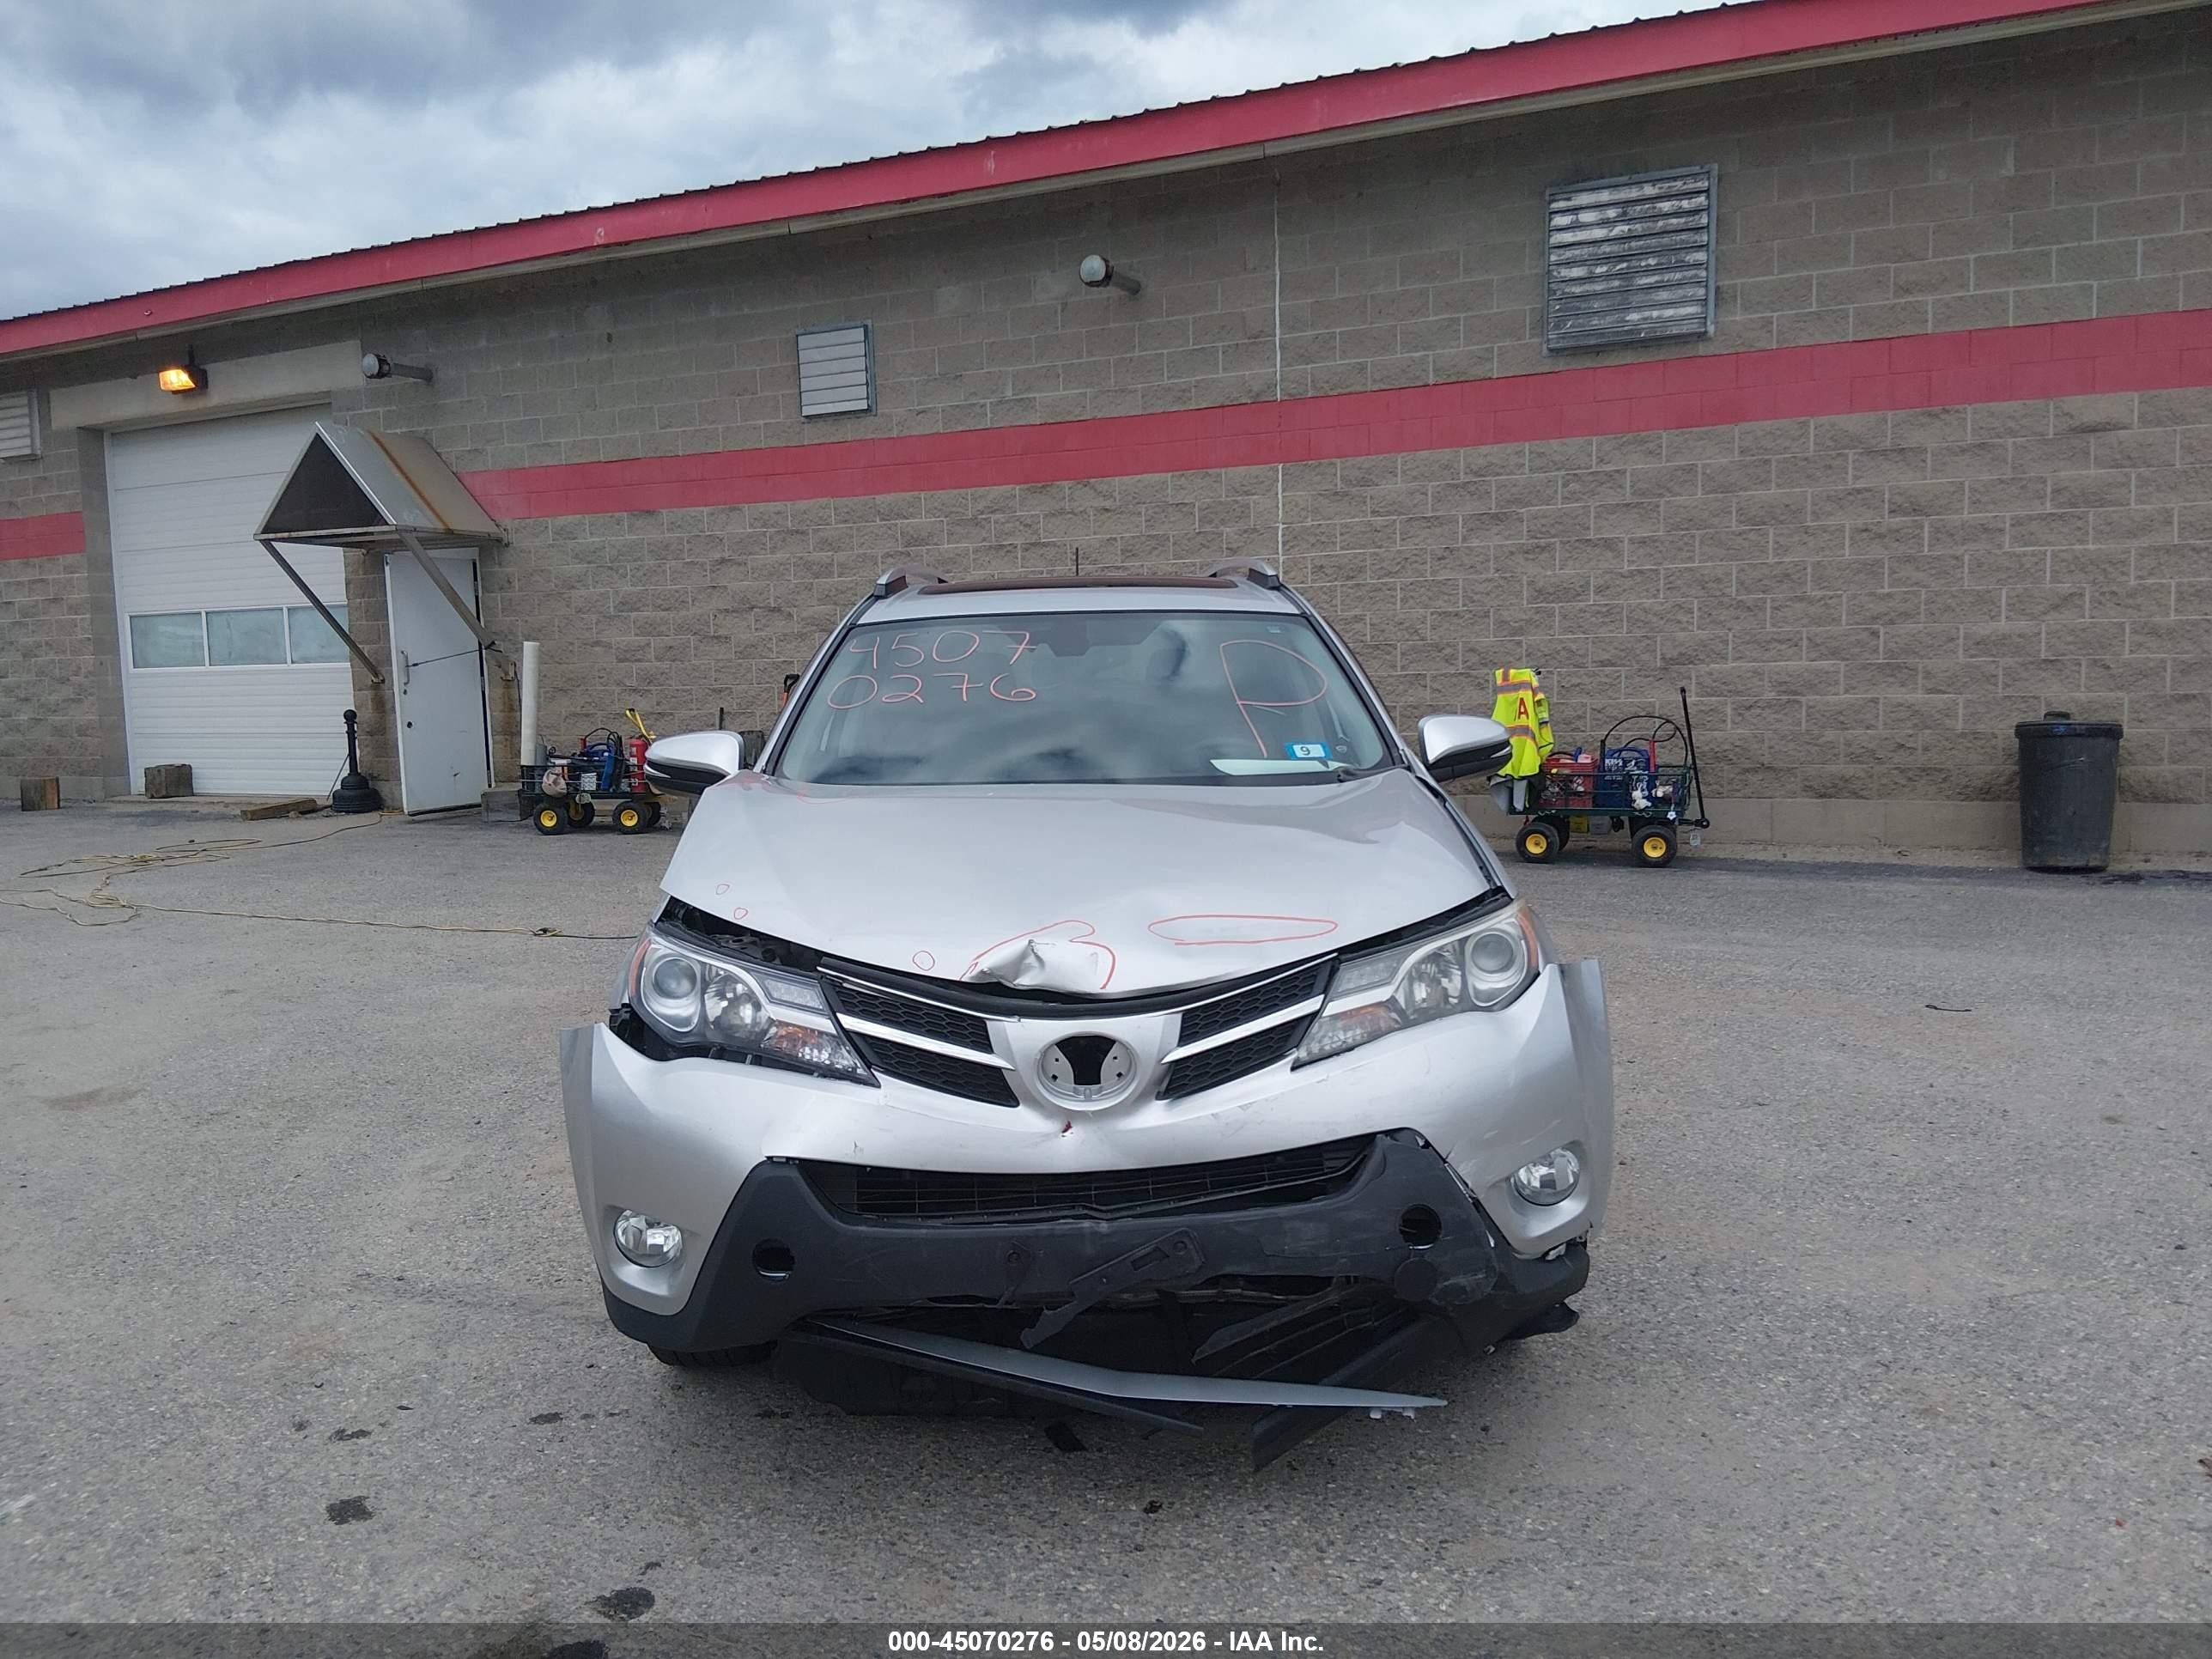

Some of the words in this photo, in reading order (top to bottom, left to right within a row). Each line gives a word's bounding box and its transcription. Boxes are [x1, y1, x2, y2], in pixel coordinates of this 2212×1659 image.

[849, 629, 1037, 669] 4507
[827, 672, 1036, 709] 0276
[1219, 639, 1328, 757] P
[1300, 745, 1311, 757] 9
